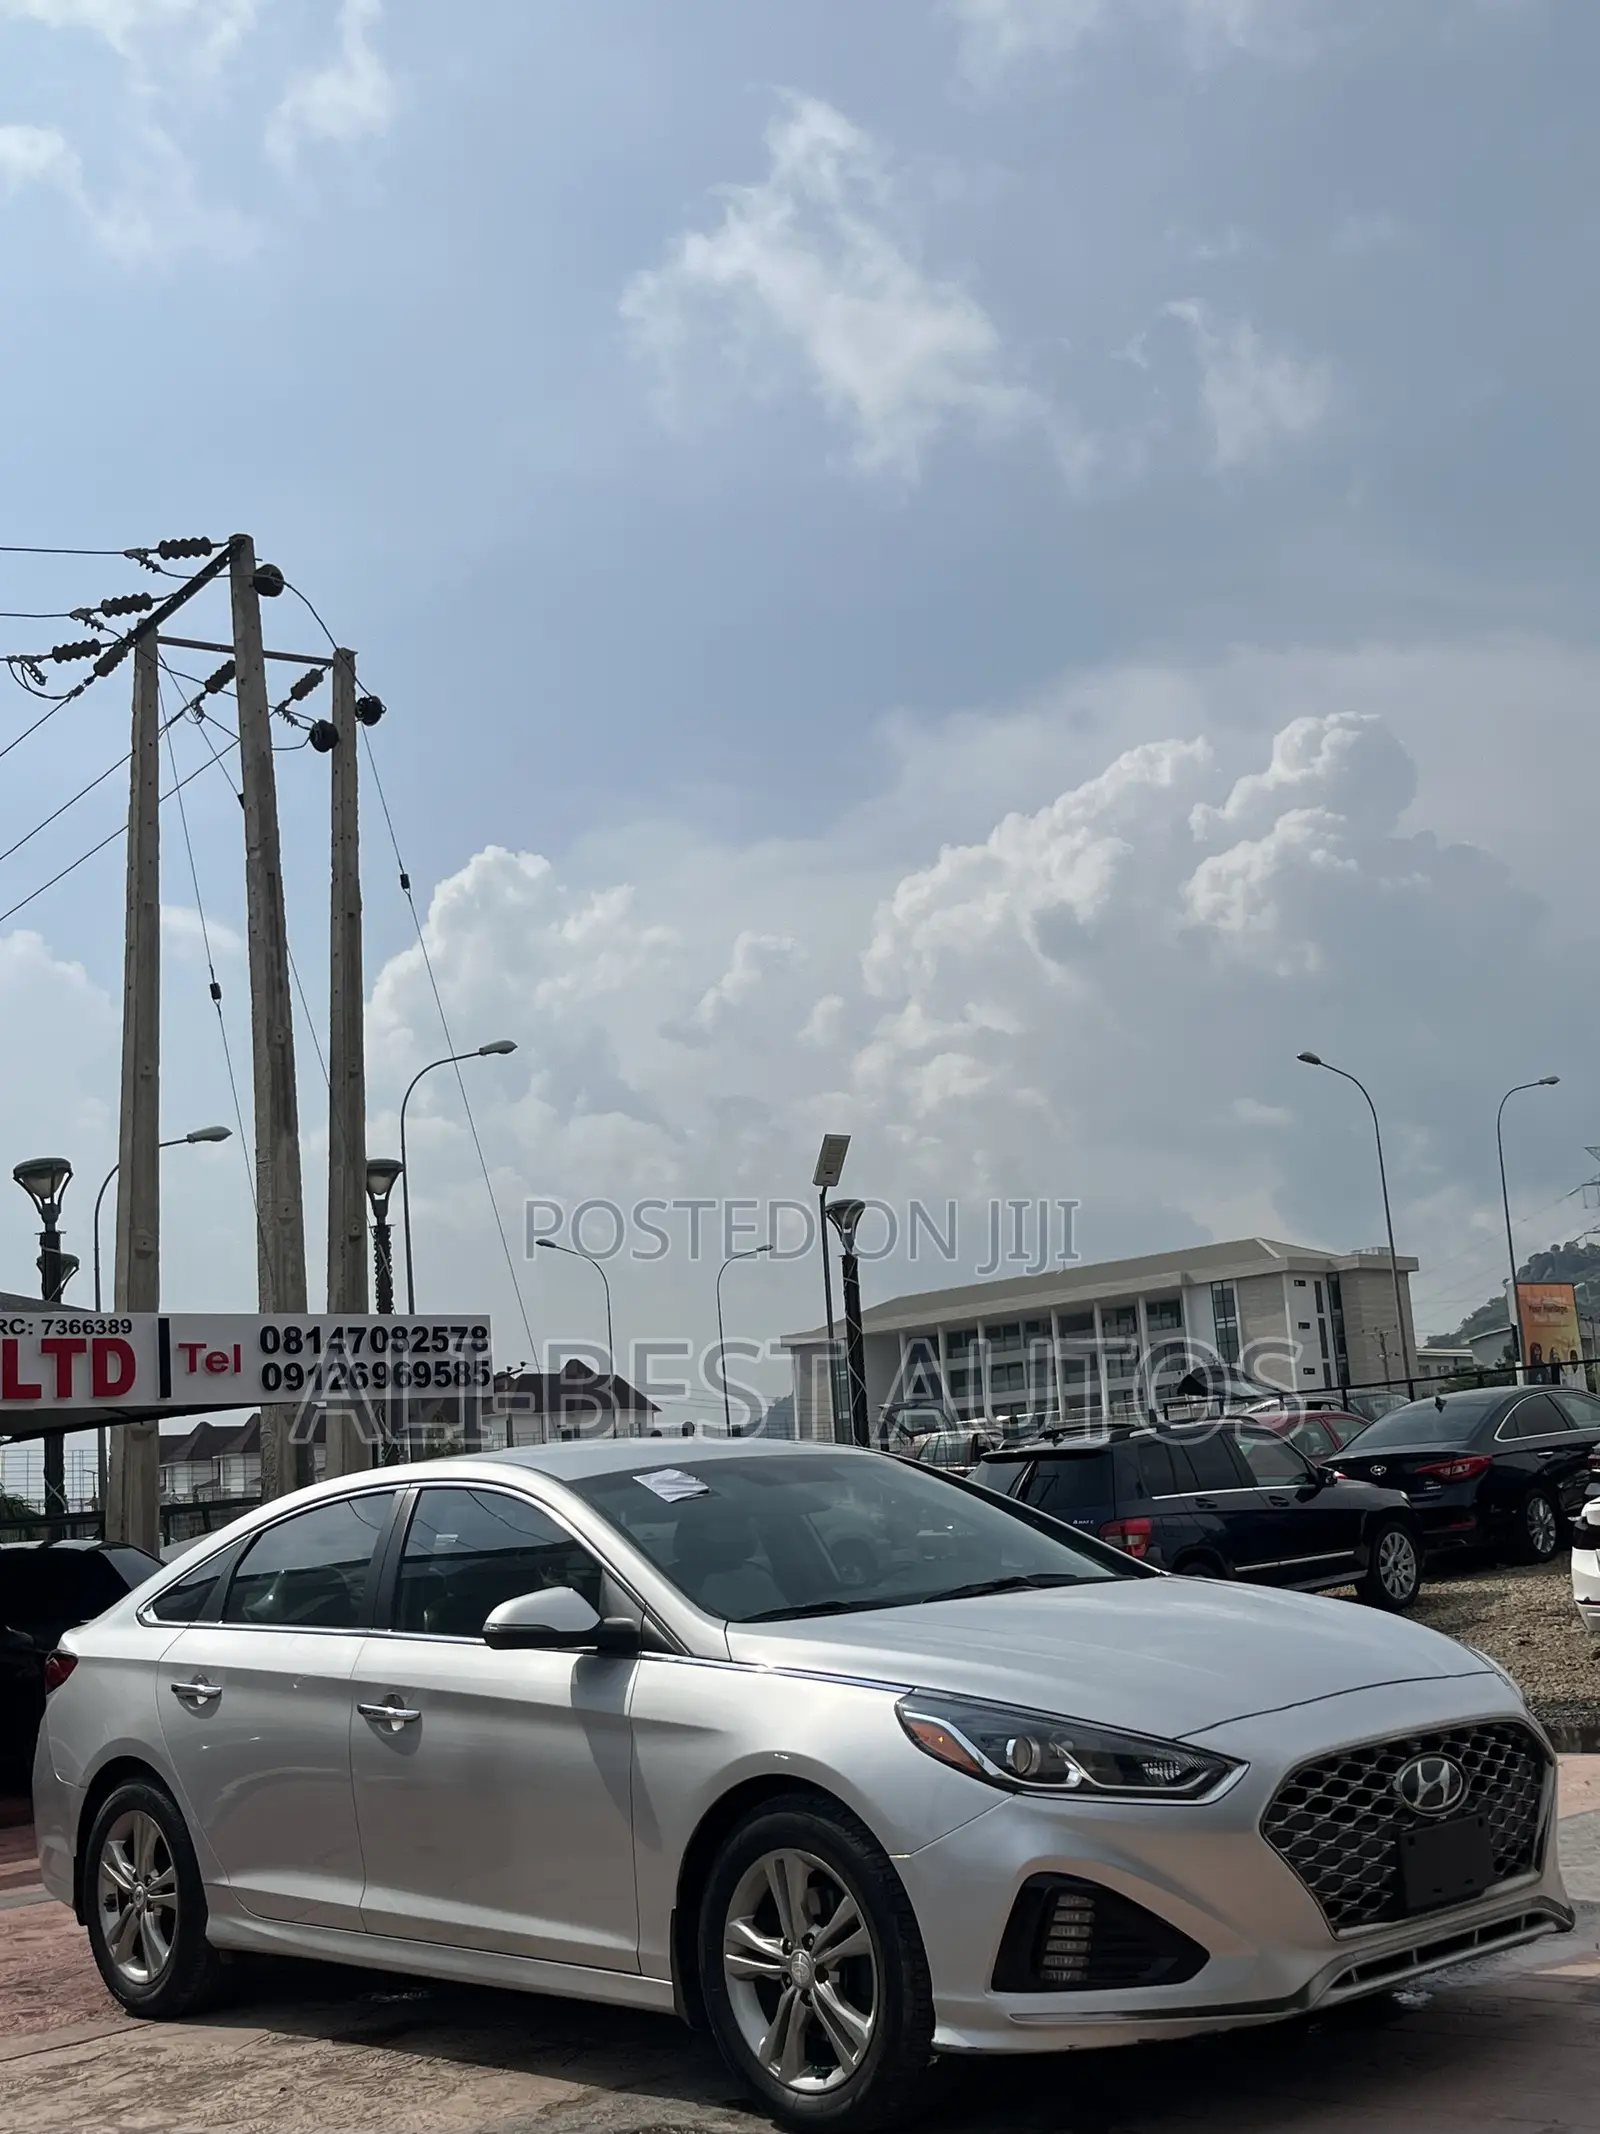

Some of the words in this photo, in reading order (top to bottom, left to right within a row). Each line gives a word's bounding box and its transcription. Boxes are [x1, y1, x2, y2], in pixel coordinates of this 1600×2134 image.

[41, 1318, 133, 1336] 7366389
[259, 1325, 489, 1355] 08147082578
[2, 1338, 136, 1400] LTD
[179, 1343, 242, 1374] Tel
[261, 1360, 491, 1392] 09126969585
